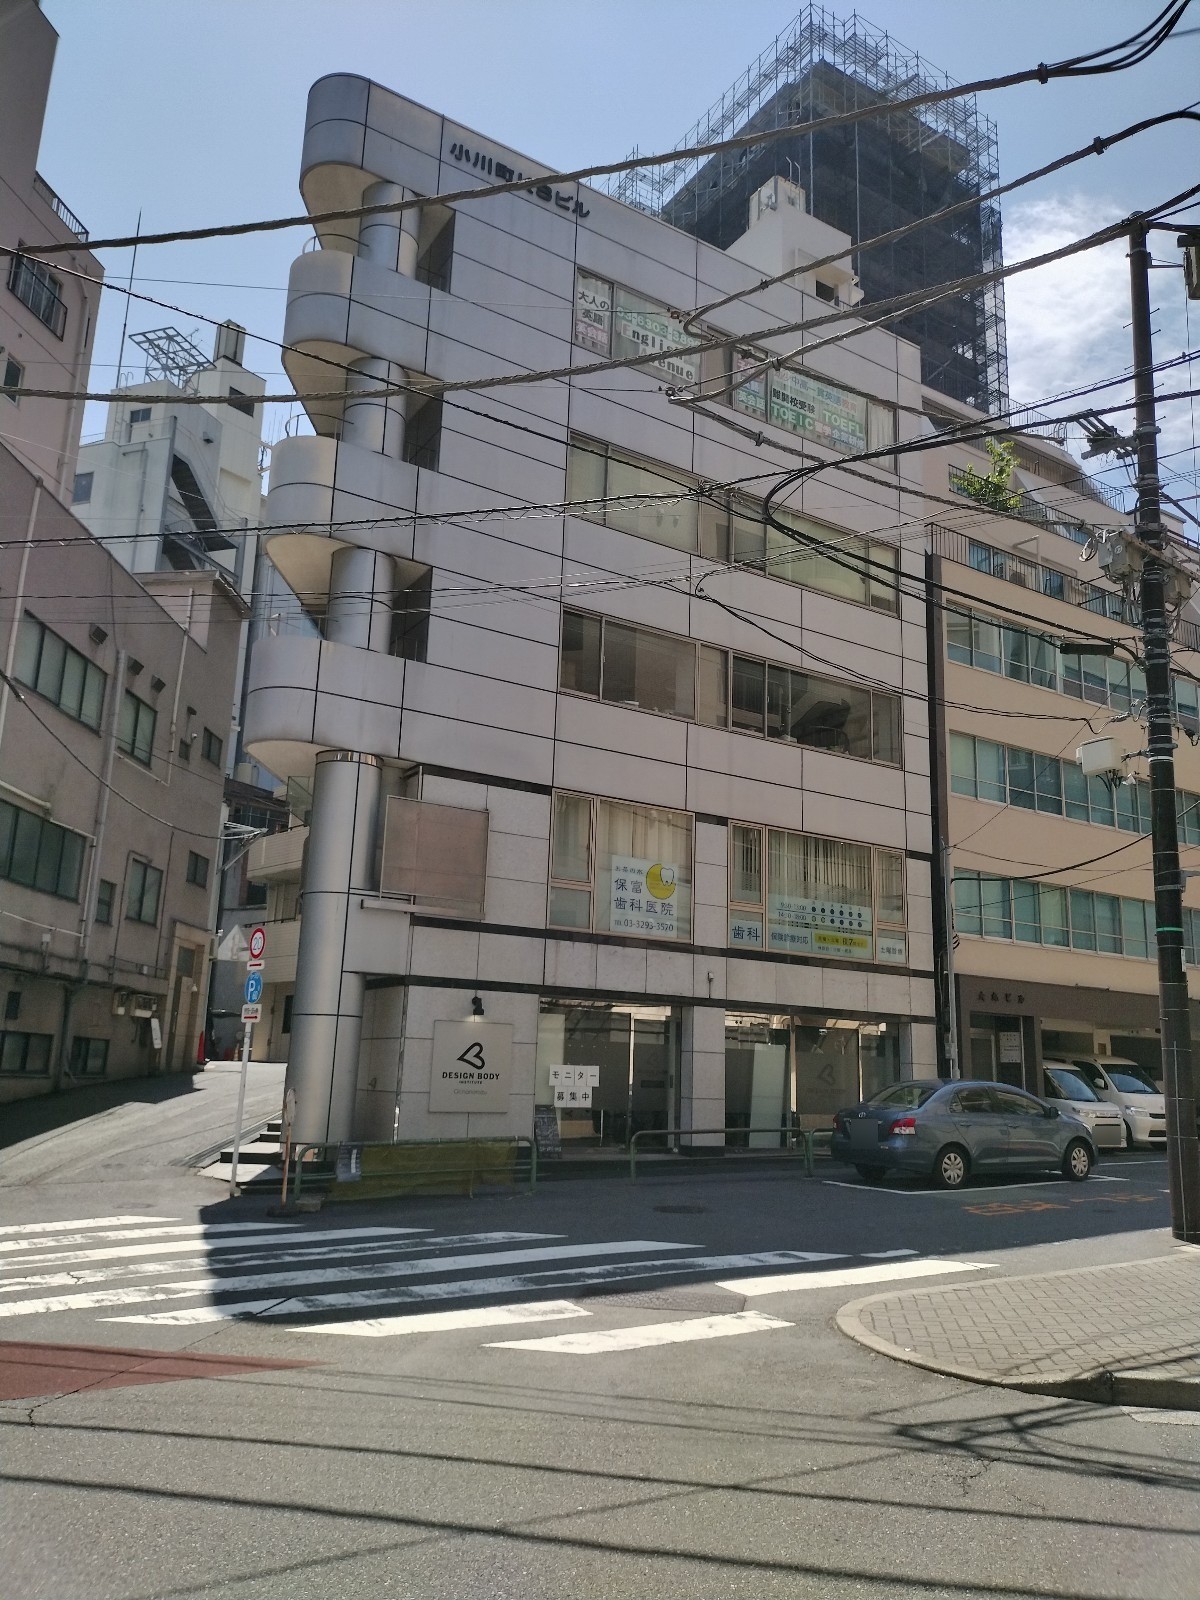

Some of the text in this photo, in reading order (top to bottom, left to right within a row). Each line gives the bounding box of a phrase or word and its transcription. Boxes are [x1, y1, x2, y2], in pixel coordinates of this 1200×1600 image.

[578, 291, 610, 310] 大人の
[771, 404, 814, 430] TOEIC
[822, 410, 864, 436] TOEFL
[614, 877, 643, 894] 保富
[613, 896, 674, 916] 歯科医院
[623, 918, 674, 932] 03-3293-3570
[732, 925, 761, 942] 歯科
[253, 936, 262, 951] 20
[247, 980, 256, 1000] P
[442, 1071, 500, 1080] DESIGN BODY
[551, 1070, 597, 1081] モニター
[556, 1091, 590, 1101] 募集中
